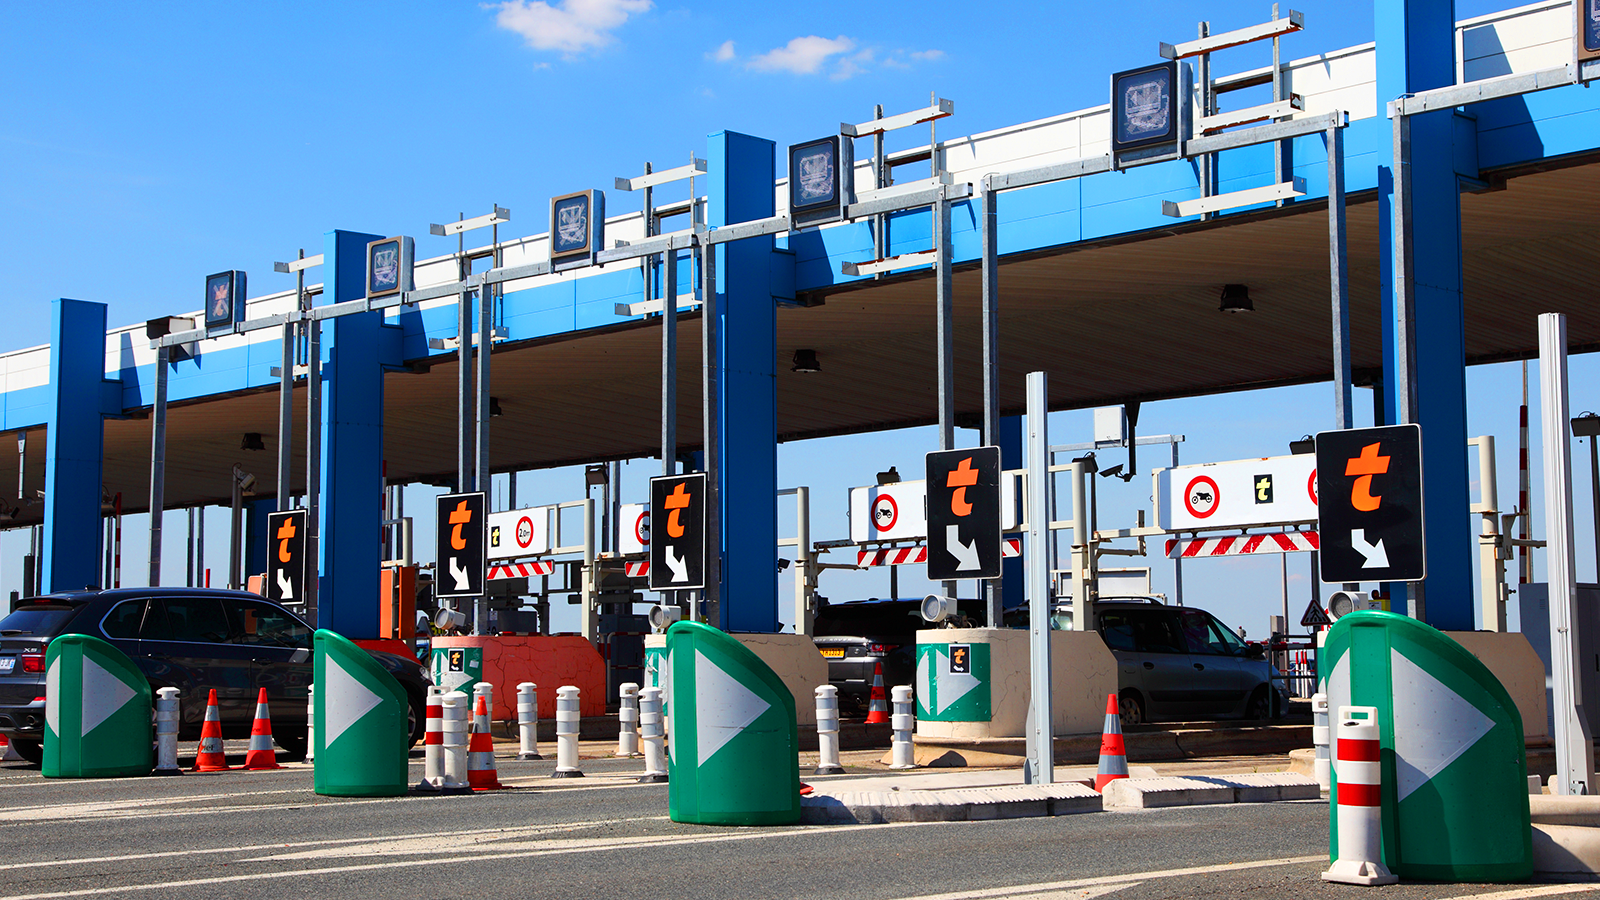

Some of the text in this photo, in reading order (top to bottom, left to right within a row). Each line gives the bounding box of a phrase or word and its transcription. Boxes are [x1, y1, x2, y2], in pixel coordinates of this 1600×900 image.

[947, 457, 979, 516] t
[1256, 478, 1270, 500] t
[1345, 442, 1391, 512] t
[449, 500, 472, 550] t
[664, 482, 691, 538] t
[277, 517, 296, 562] t
[492, 528, 500, 546] t
[451, 652, 460, 665] t
[954, 648, 966, 665] t
